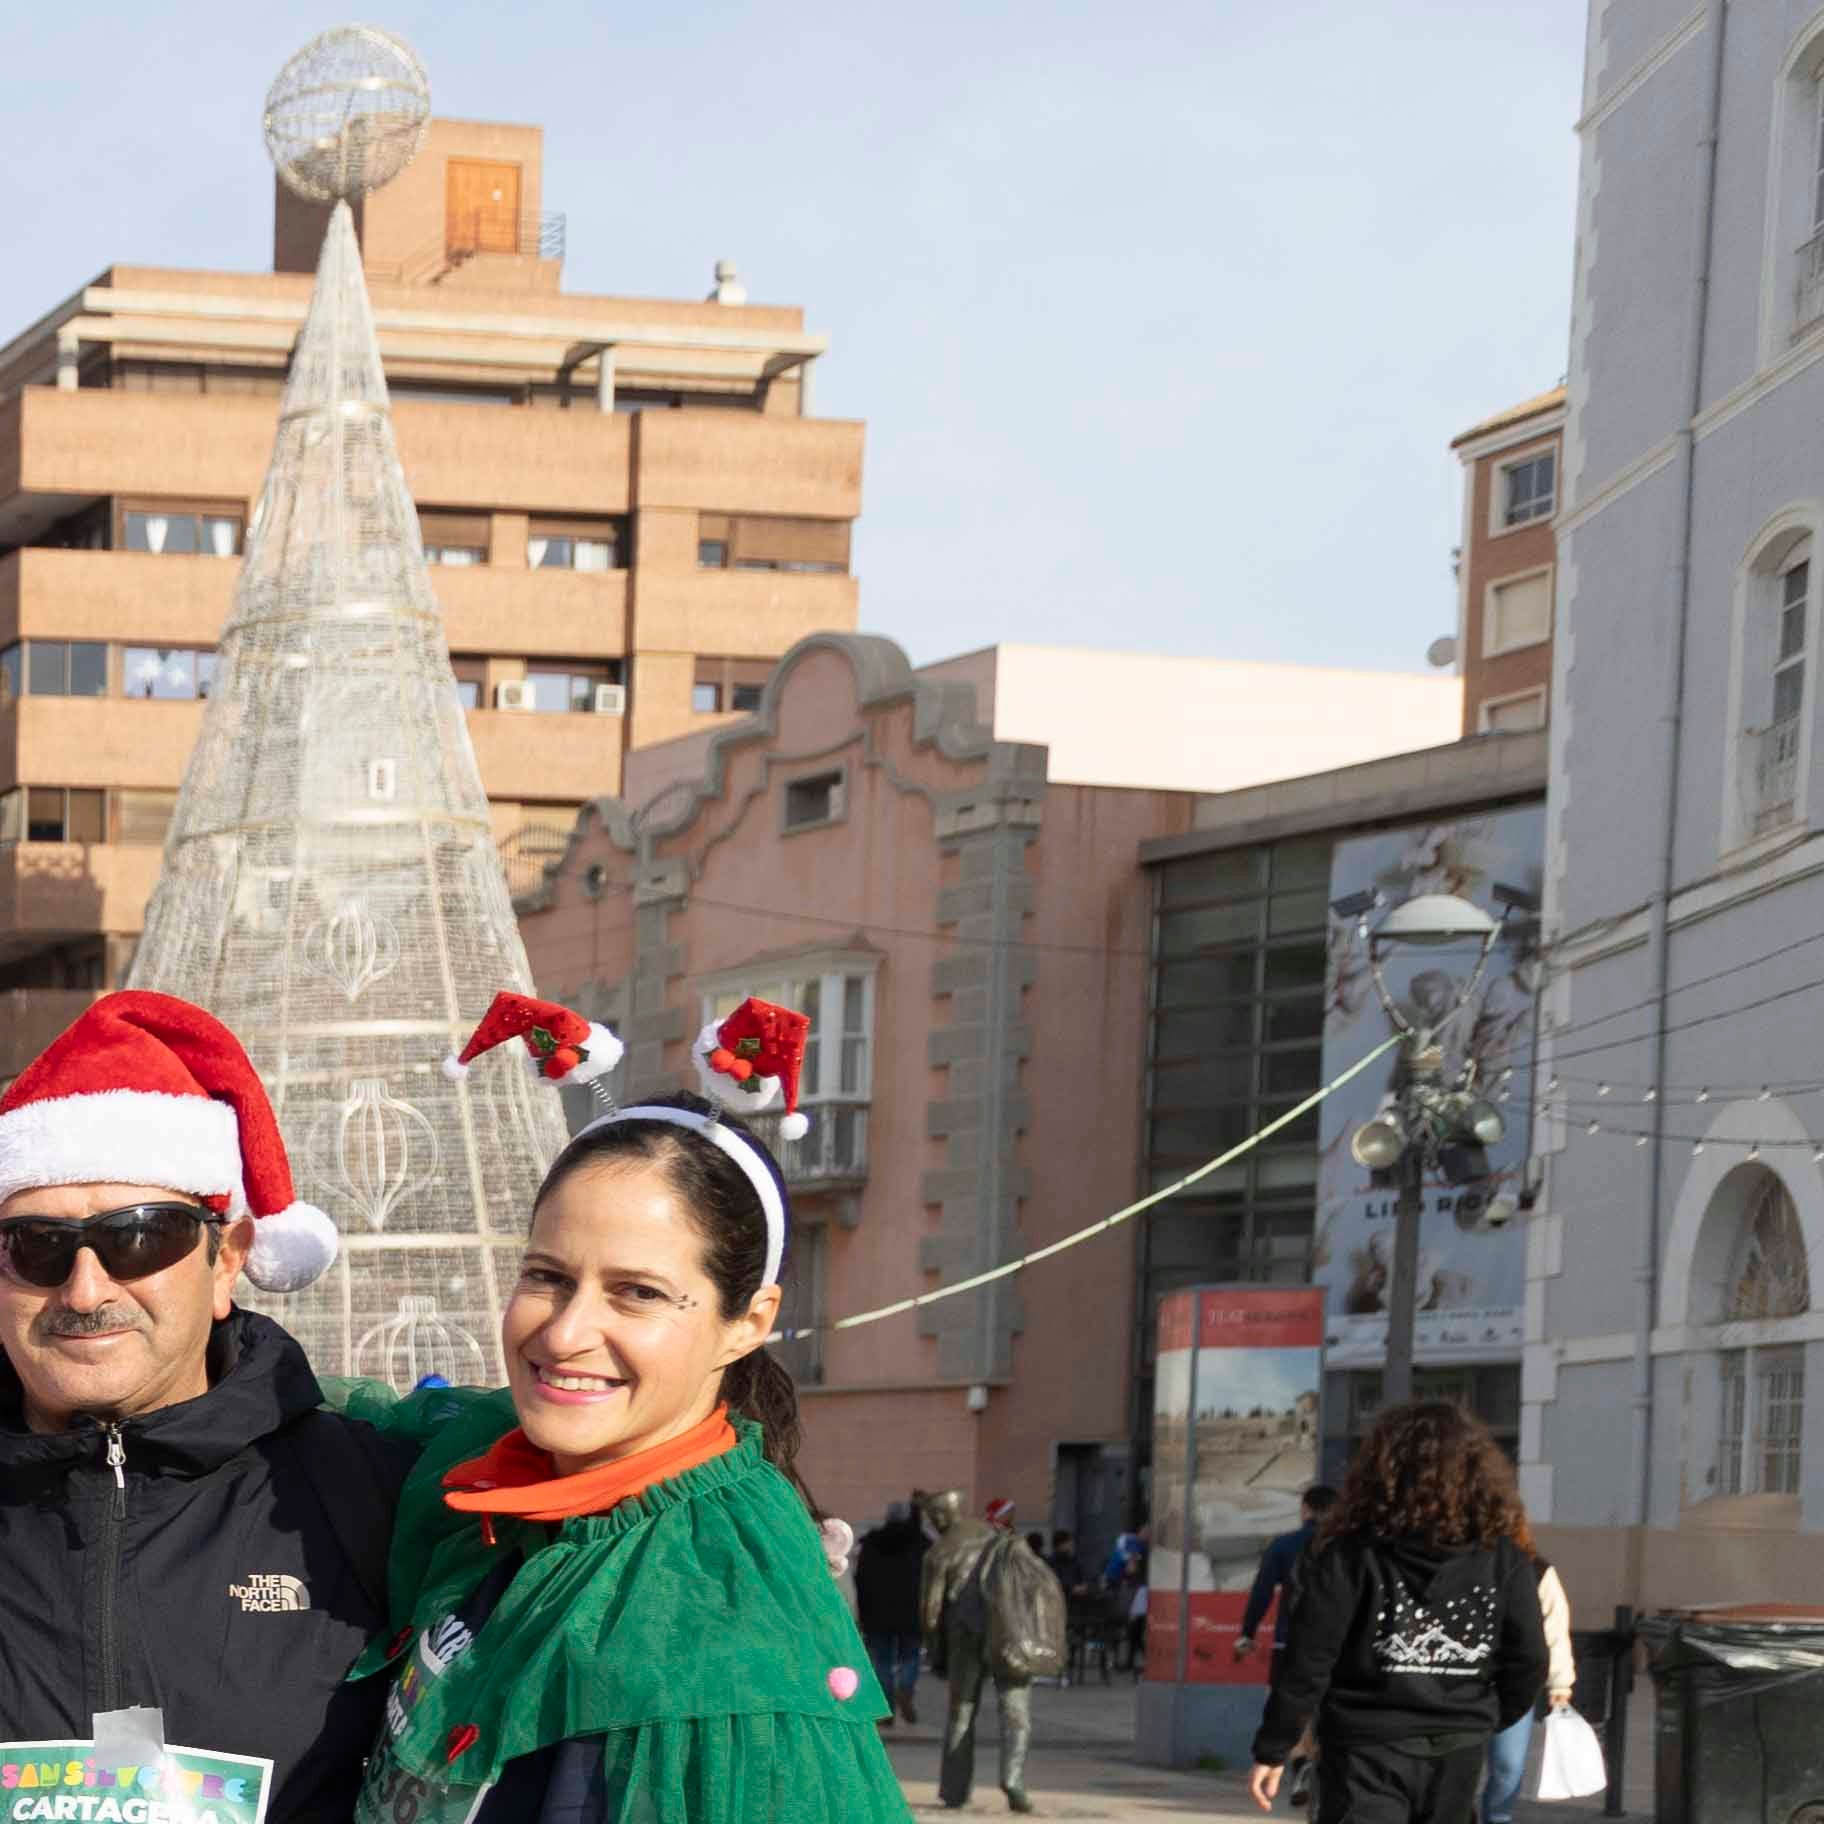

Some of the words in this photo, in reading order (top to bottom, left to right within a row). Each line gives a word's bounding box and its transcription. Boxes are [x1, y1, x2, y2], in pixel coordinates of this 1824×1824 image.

[248, 1574, 280, 1587] THE
[229, 1583, 280, 1599] NORTH
[241, 1599, 280, 1611] FACE
[0, 1762, 61, 1790] SAN
